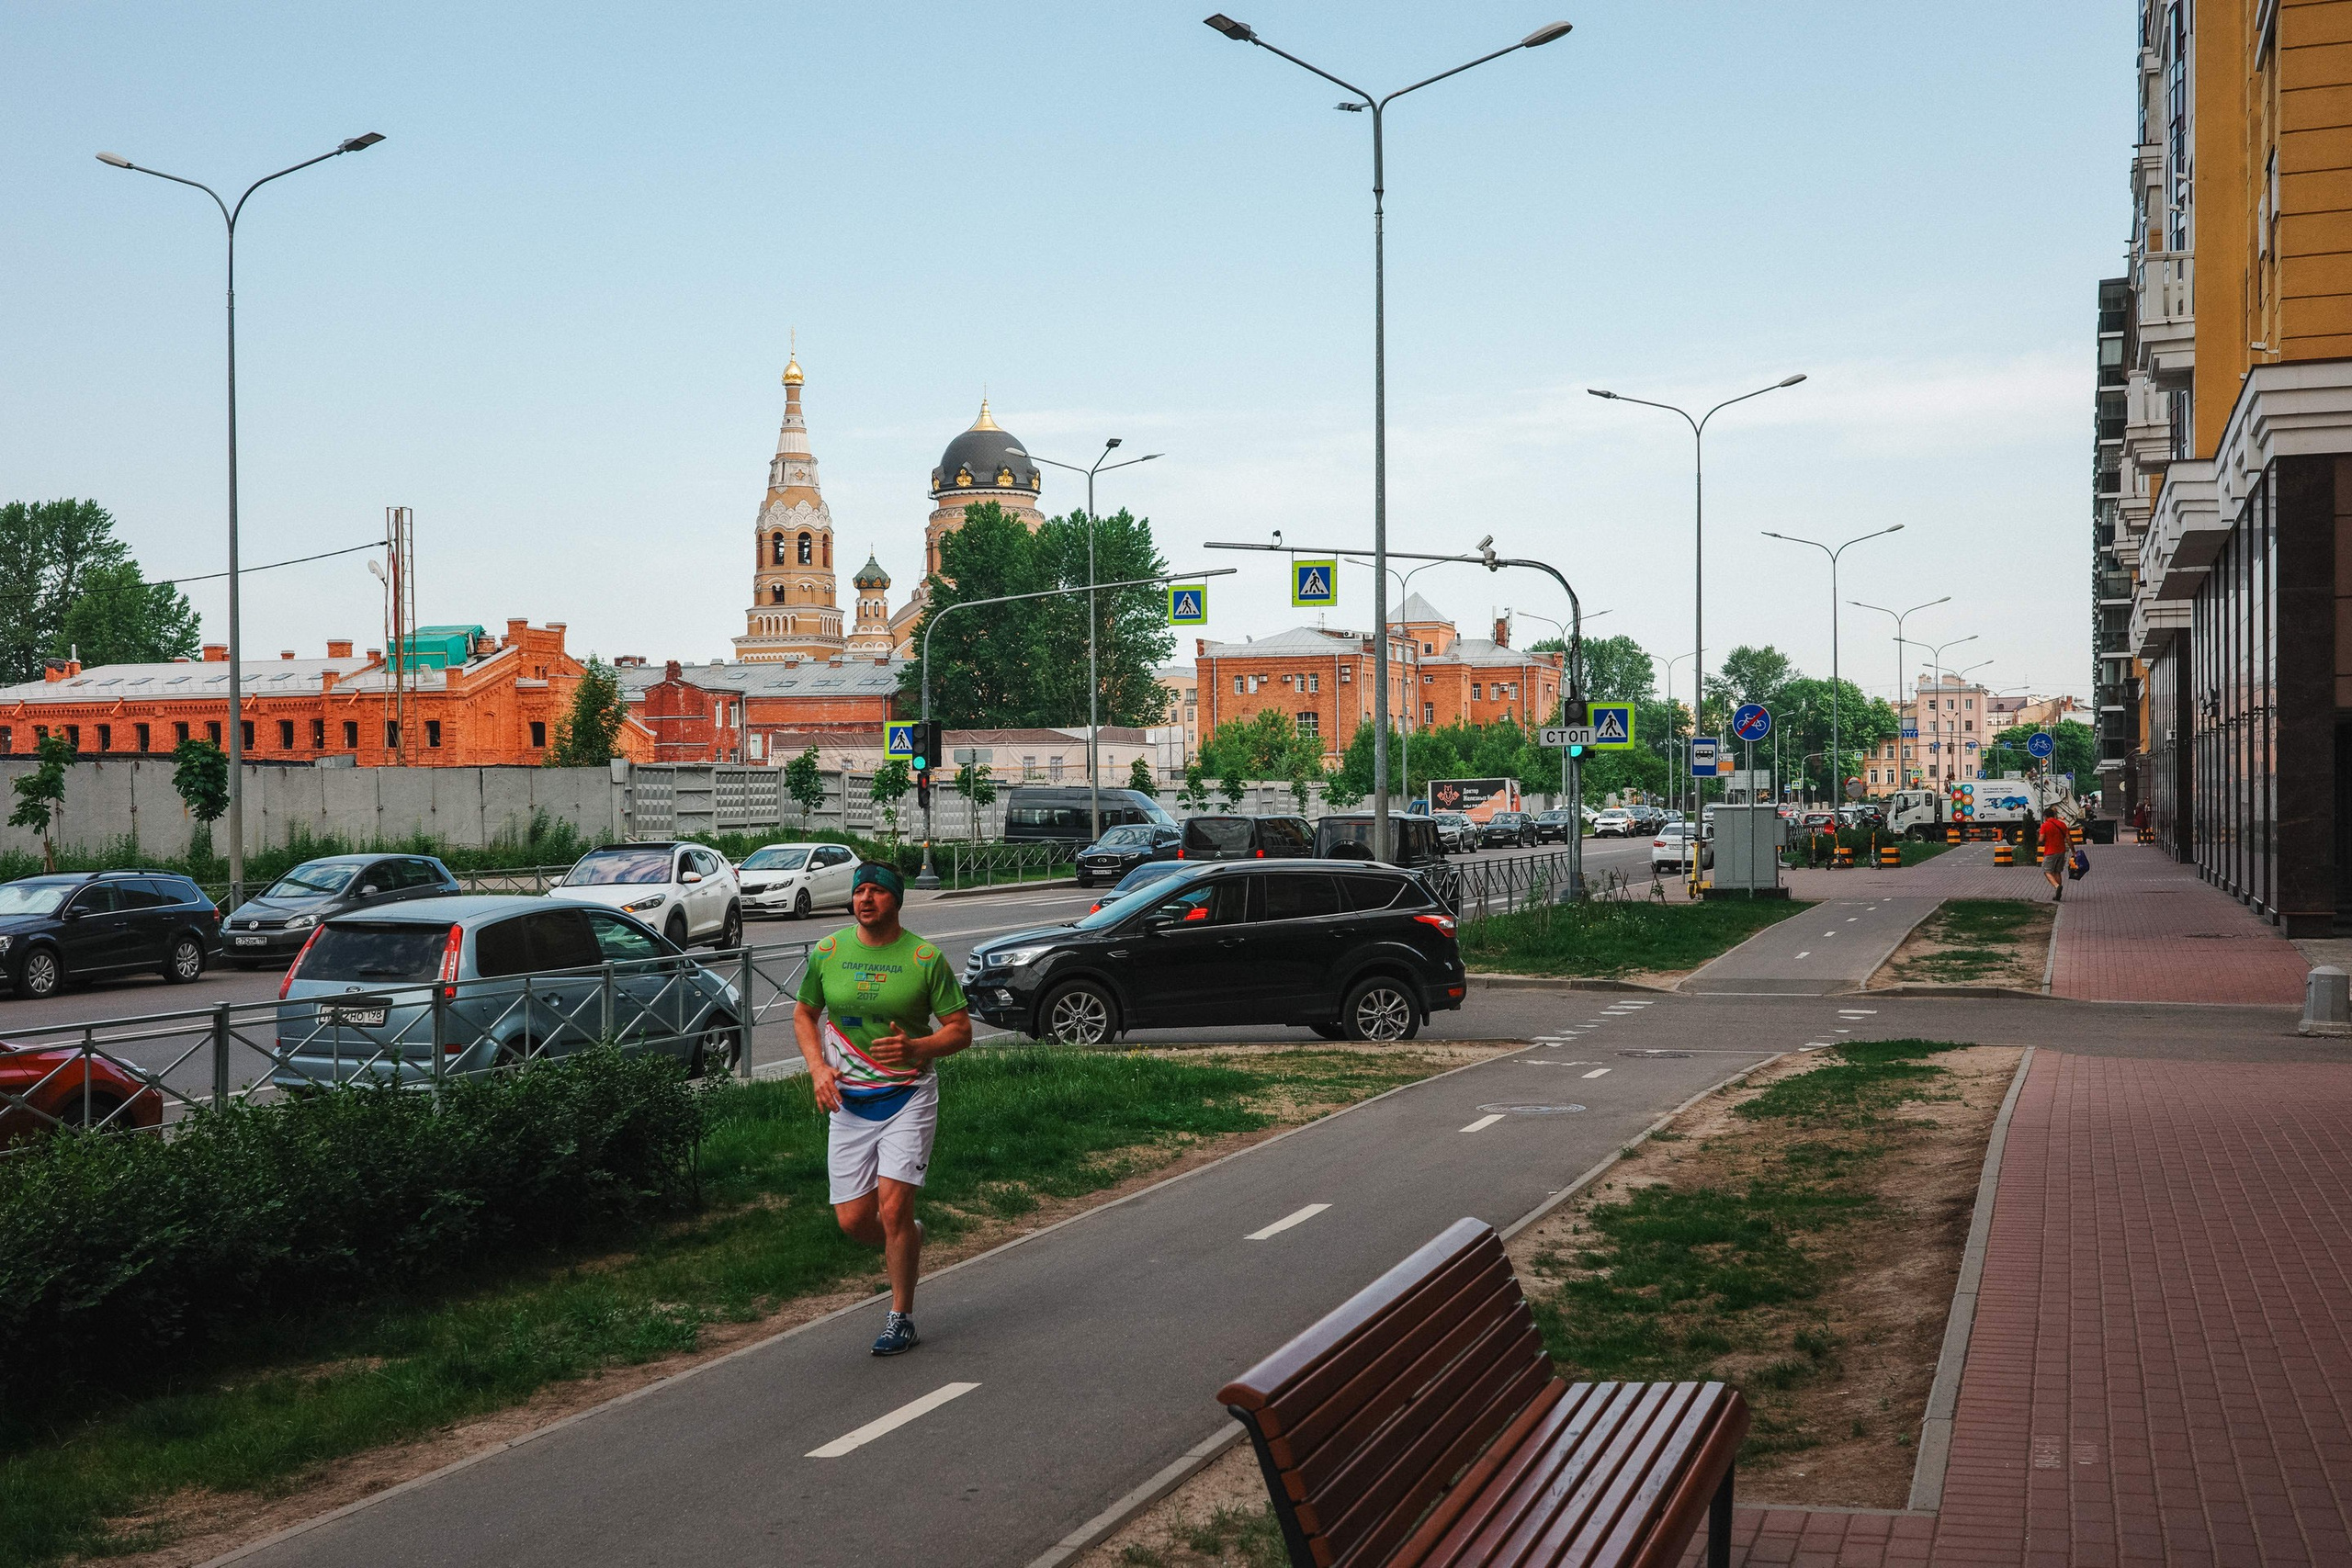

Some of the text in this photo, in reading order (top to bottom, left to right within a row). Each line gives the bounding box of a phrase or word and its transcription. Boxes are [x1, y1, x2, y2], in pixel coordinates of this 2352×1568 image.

[1546, 730, 1589, 743] СТОП
[842, 962, 903, 973] СПАРТАКИАДА
[857, 992, 878, 1000] 2017
